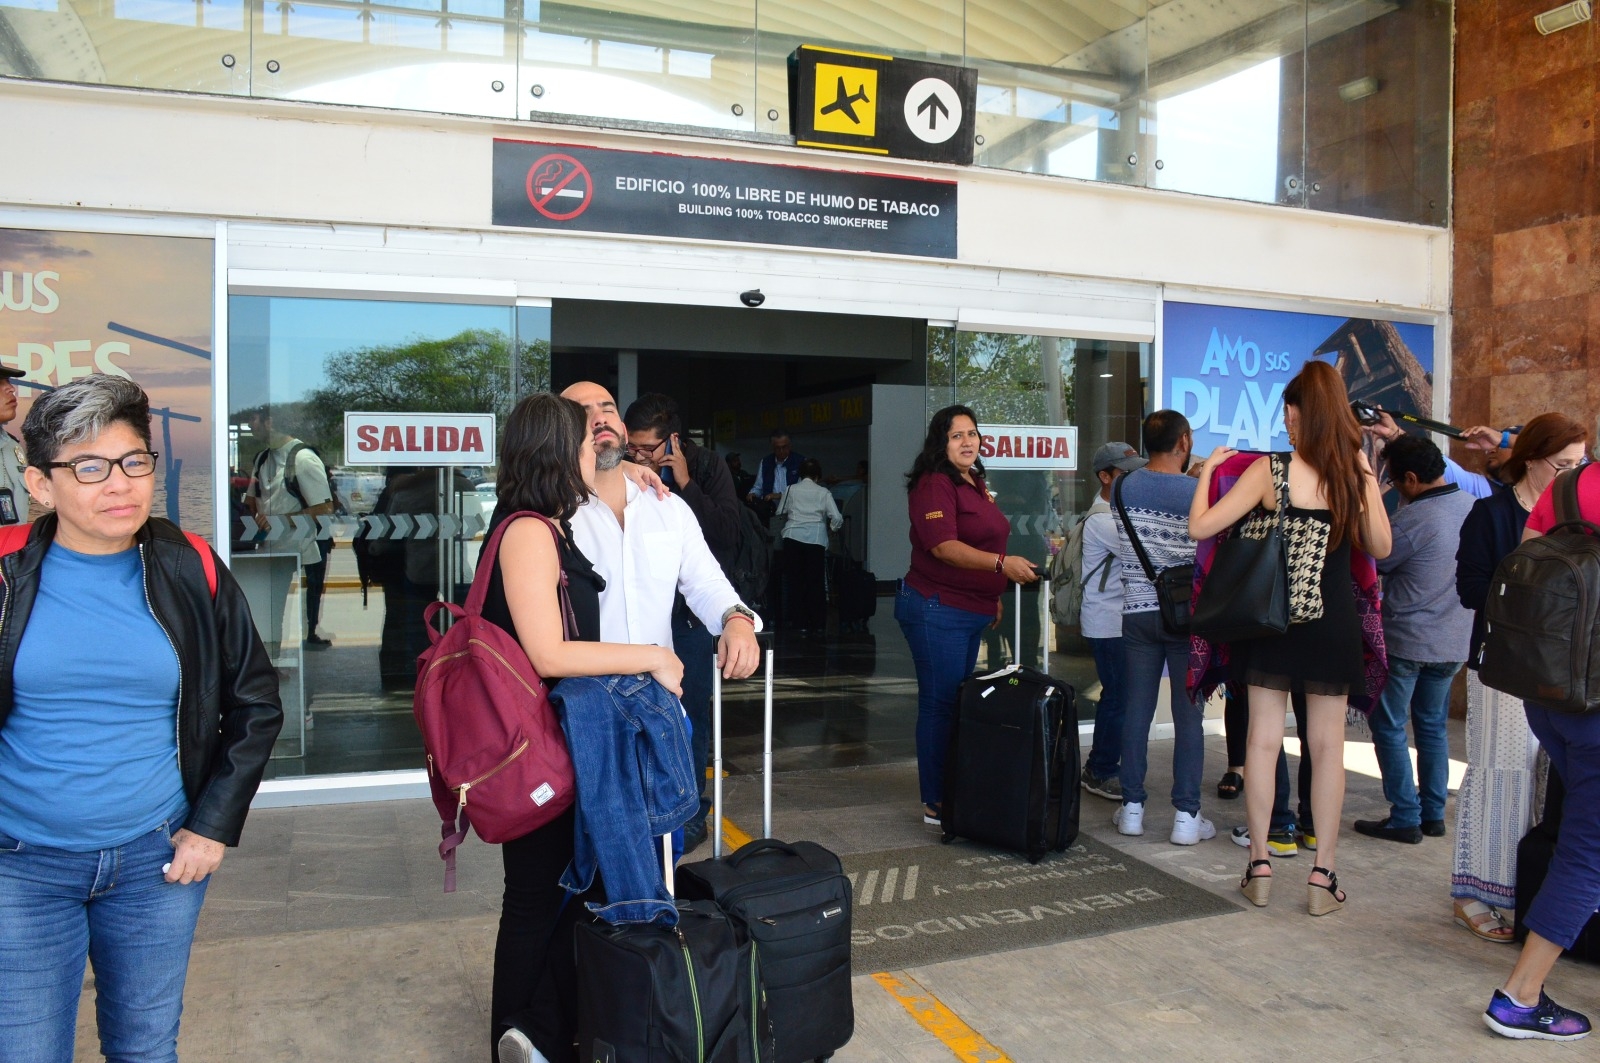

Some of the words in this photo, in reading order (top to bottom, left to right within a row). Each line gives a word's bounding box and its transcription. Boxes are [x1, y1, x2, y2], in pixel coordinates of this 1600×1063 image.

[615, 176, 685, 195] EDIFICIO
[691, 182, 731, 199] 100%
[736, 186, 781, 203] LIBRE
[785, 190, 806, 205] DE
[810, 193, 855, 209] HUMO
[858, 197, 878, 211] DE
[881, 200, 940, 217] TABACO
[678, 203, 733, 217] BUILDING
[735, 208, 763, 220] 100%
[766, 210, 820, 224] TOBACCO
[823, 215, 889, 230] SMOKEFREE
[0, 270, 60, 314] US
[0, 339, 133, 398] RES
[1200, 326, 1261, 377] AMO
[840, 396, 864, 419] TAXI
[356, 425, 484, 452] SALIDA
[979, 435, 1070, 459] SALIDA
[851, 886, 1166, 945] BIENVENIDOS
